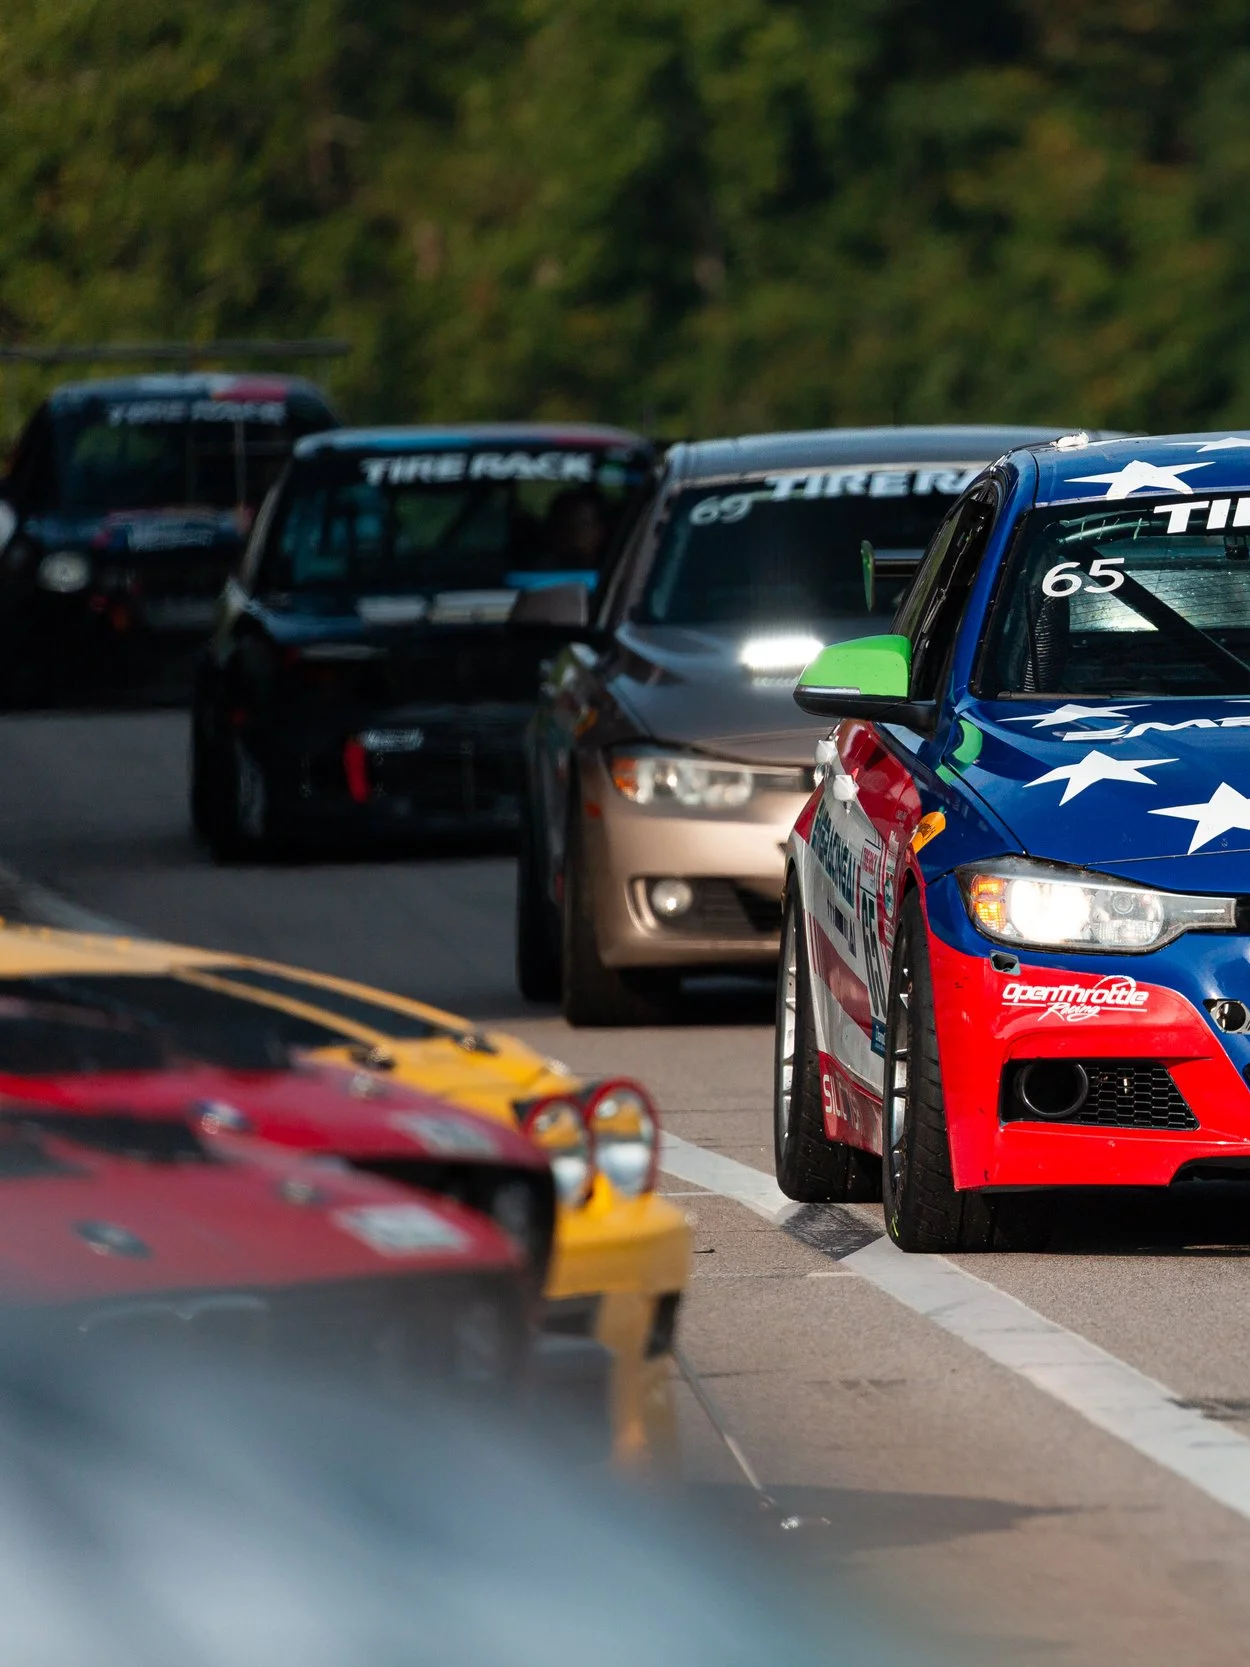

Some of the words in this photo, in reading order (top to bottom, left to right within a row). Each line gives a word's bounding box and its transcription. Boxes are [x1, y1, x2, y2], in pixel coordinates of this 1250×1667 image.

[360, 452, 468, 486] TIRE
[469, 451, 593, 483] RACK
[765, 468, 910, 501] TIRE
[690, 491, 752, 527] 69
[1041, 556, 1125, 599] 65
[1037, 1001, 1100, 1023] Racing
